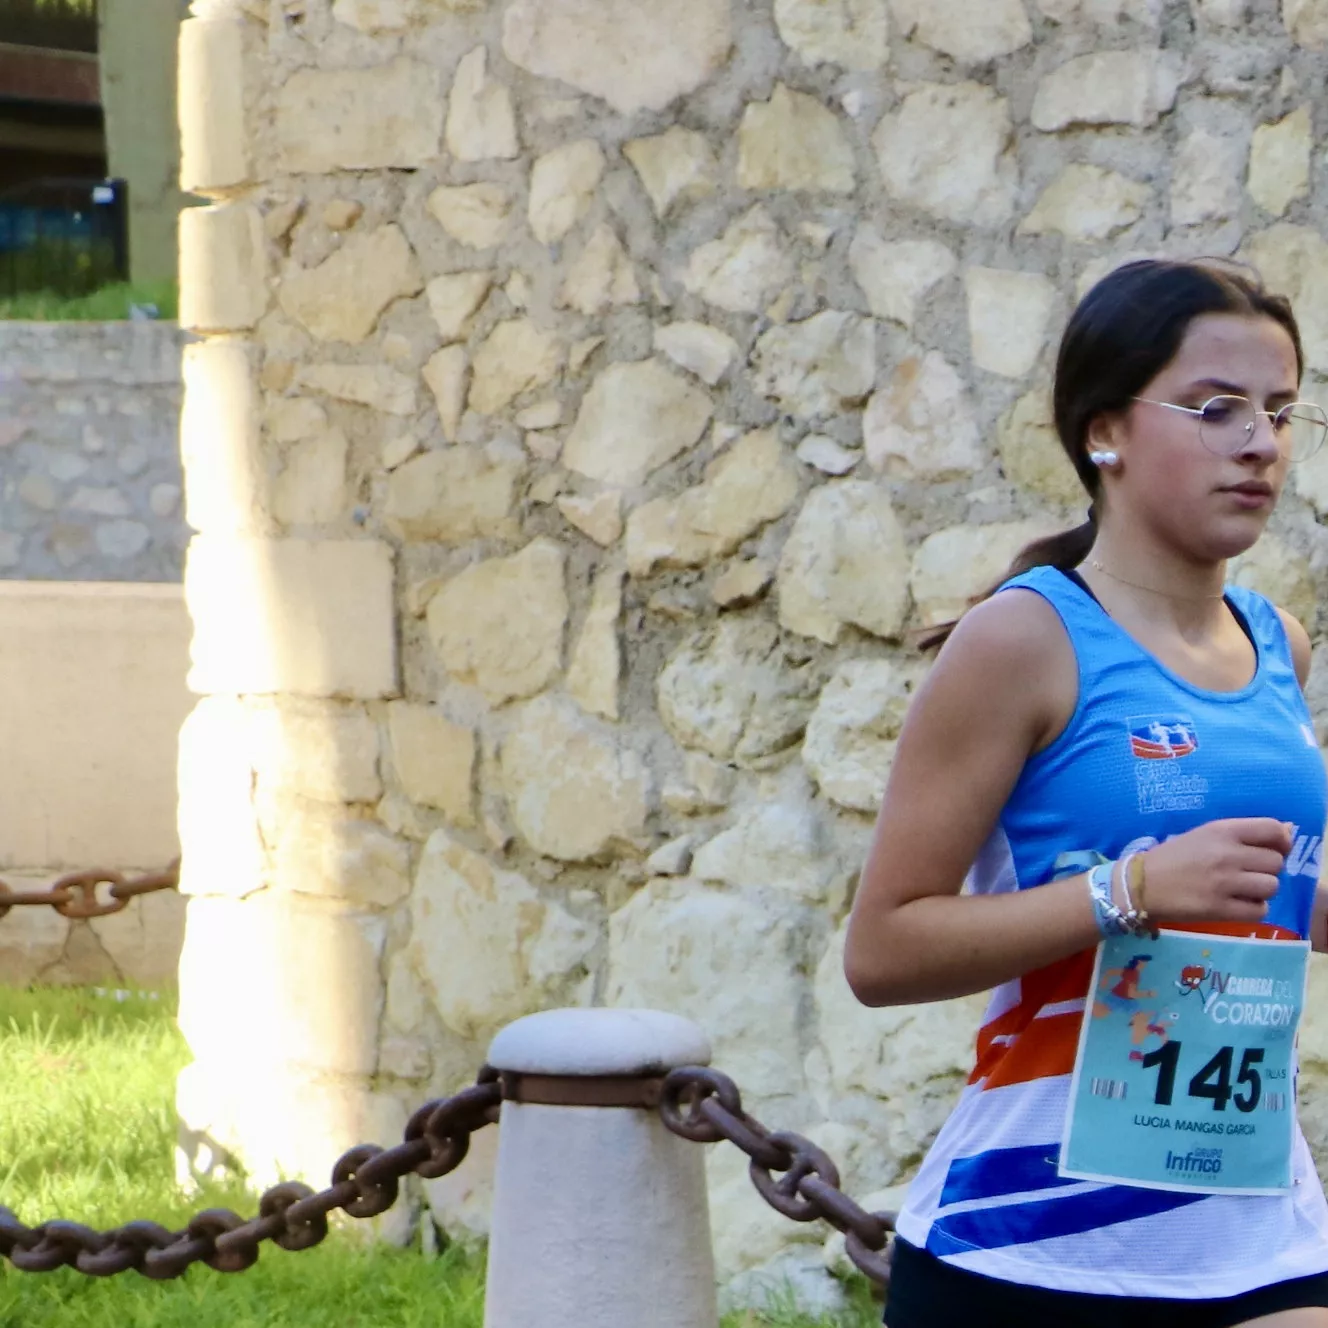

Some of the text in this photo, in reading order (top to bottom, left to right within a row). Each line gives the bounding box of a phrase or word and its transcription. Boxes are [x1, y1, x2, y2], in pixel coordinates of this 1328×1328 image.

[1142, 1040, 1265, 1112] 145
[1134, 1114, 1171, 1128] LUCIA
[1175, 1119, 1224, 1134] MANGAS
[1166, 1150, 1222, 1173] Infrico
